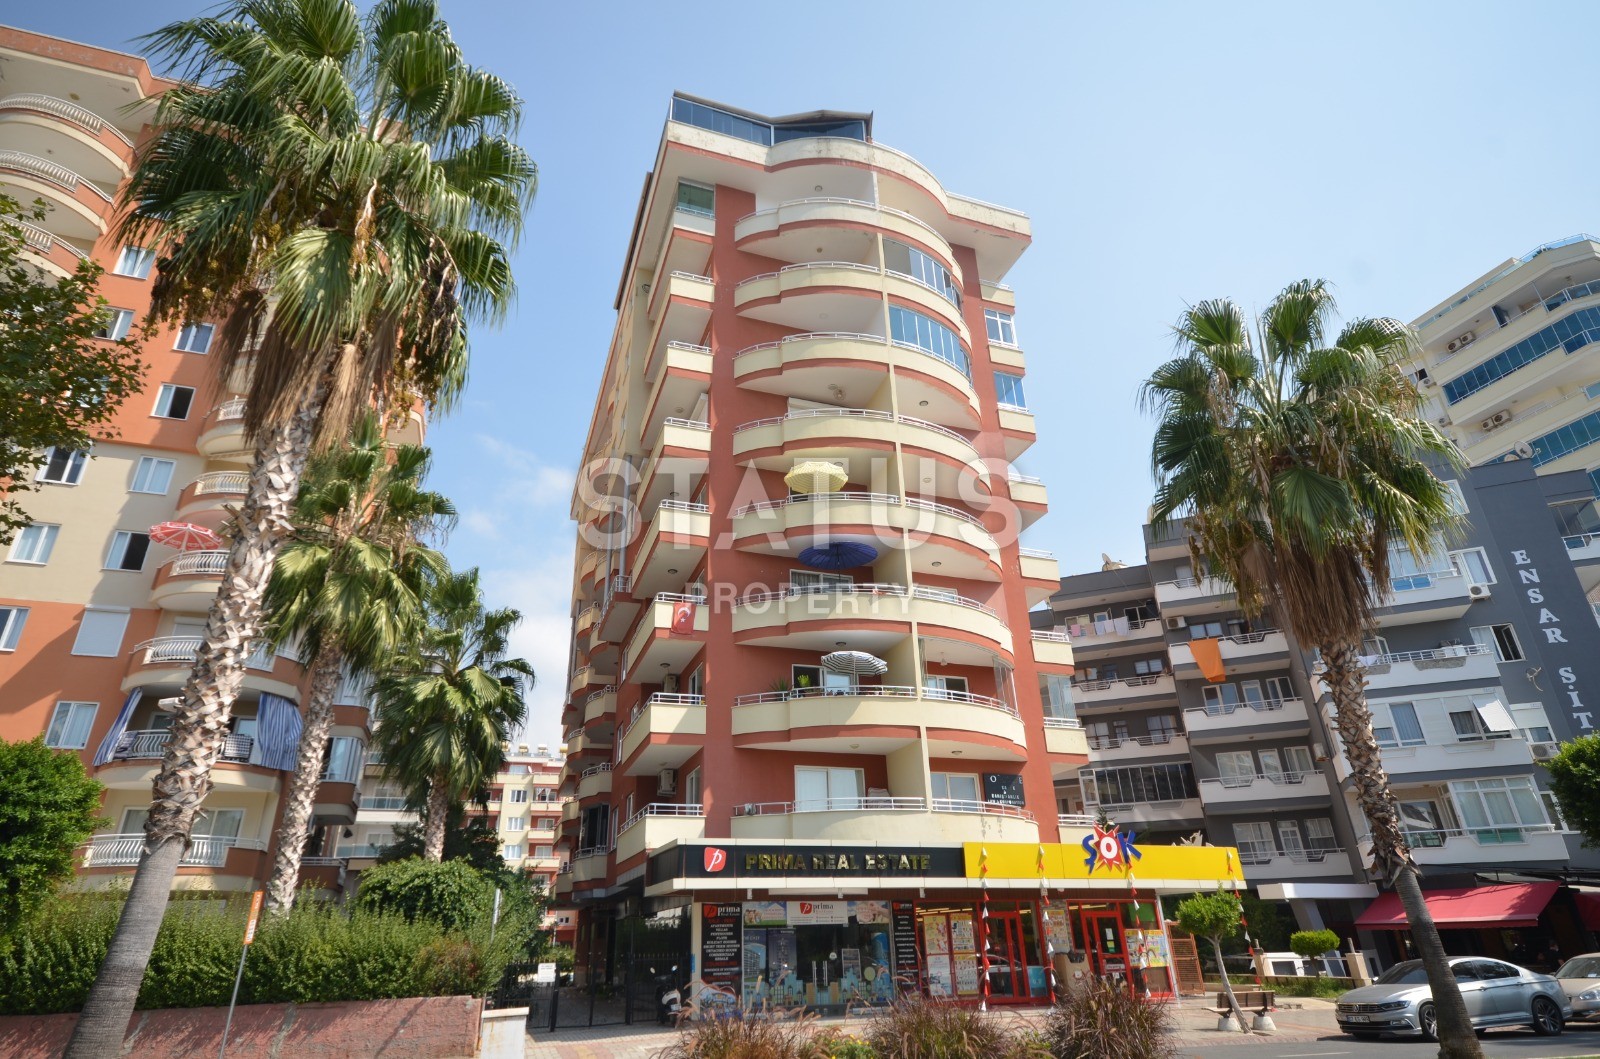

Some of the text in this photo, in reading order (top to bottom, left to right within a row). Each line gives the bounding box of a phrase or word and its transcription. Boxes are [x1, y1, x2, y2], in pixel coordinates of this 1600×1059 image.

[1510, 549, 1568, 644] ENSAR
[745, 853, 931, 870] PRIMA REAL ESTATE
[717, 906, 741, 917] prima
[813, 902, 834, 912] prima
